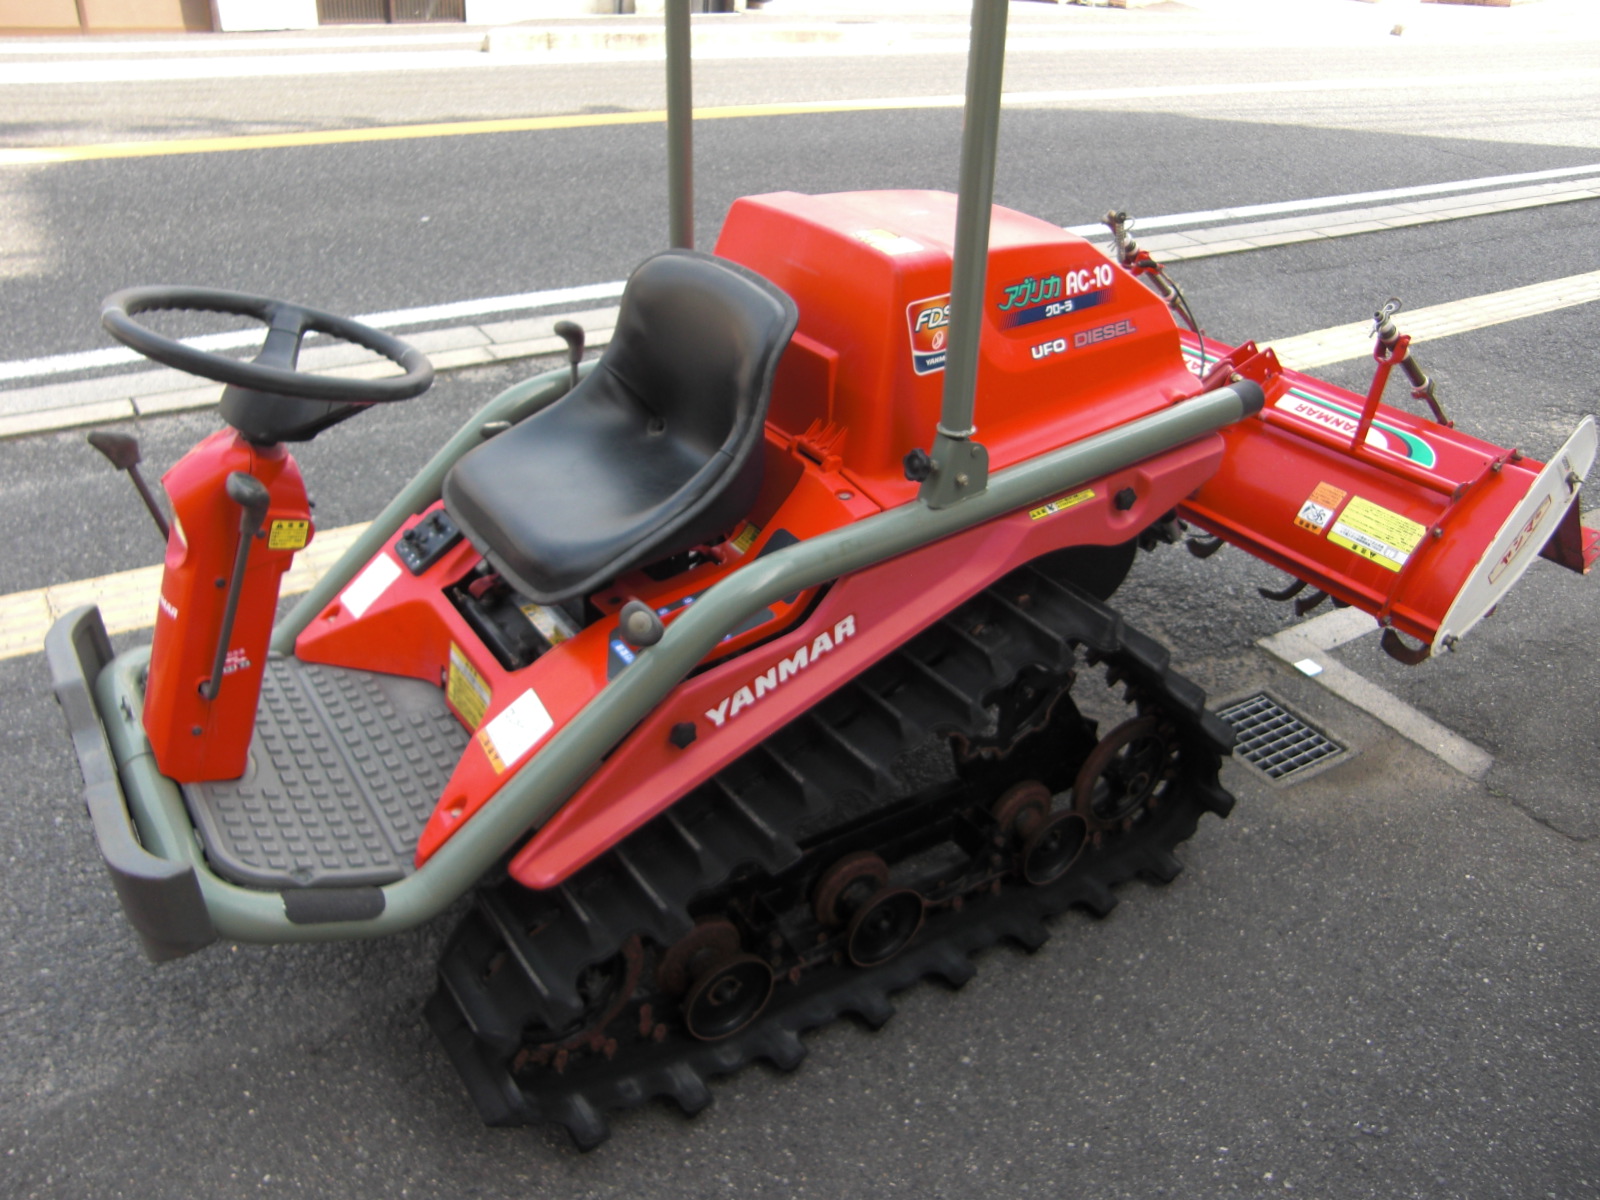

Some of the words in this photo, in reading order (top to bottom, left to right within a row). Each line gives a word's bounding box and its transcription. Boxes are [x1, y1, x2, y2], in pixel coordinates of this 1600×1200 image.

[998, 275, 1062, 311] アグリカ
[1065, 263, 1113, 296] AC-10
[1045, 300, 1073, 317] クローラ
[1031, 338, 1067, 360] UFO
[1073, 320, 1137, 347] DIESEL
[925, 355, 947, 367] YANM
[705, 614, 857, 727] YANMAR
